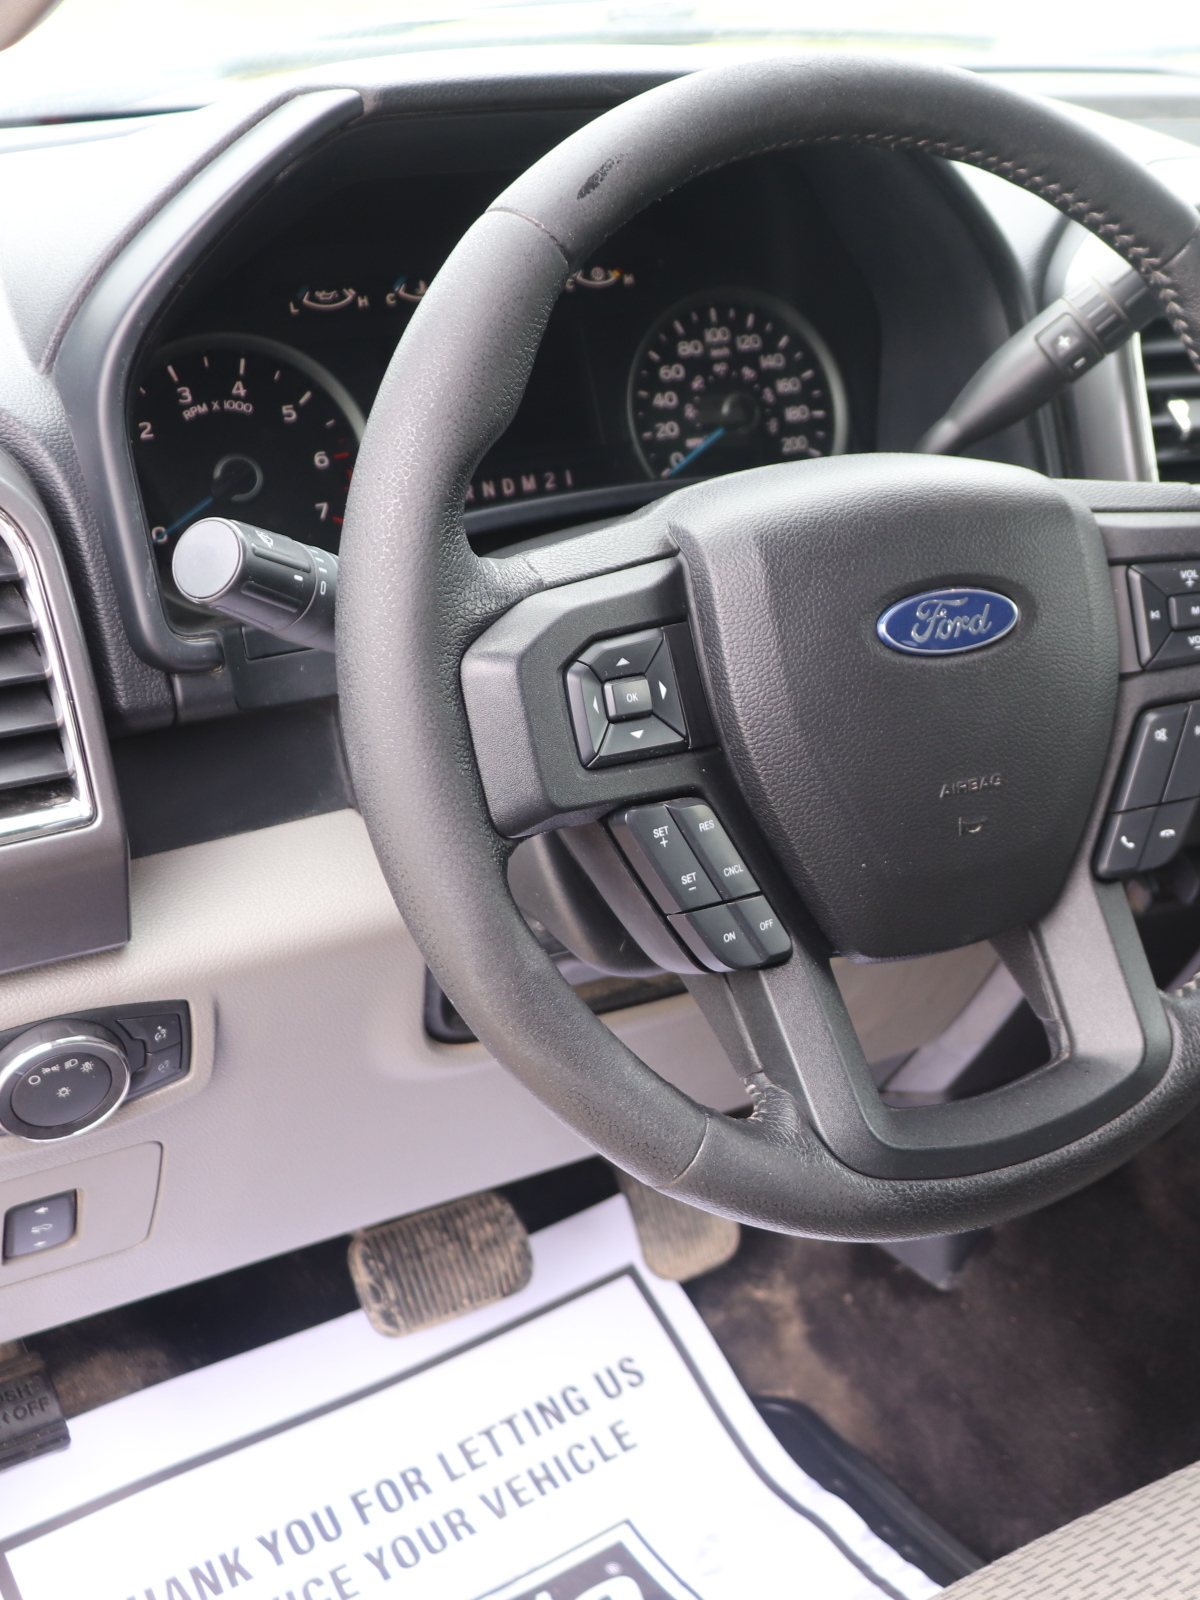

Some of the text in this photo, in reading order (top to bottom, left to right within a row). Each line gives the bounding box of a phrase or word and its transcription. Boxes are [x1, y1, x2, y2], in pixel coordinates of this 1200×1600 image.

[704, 327, 731, 343] 100
[736, 333, 762, 351] 120
[677, 340, 703, 356] 80
[759, 352, 786, 369] 140
[659, 363, 686, 381] 60
[178, 387, 193, 403] 3
[231, 381, 247, 397] 4
[652, 391, 679, 408] 40
[182, 403, 210, 421] RPM
[223, 399, 254, 414] 1000
[281, 406, 297, 422] 5
[138, 422, 154, 440] 2
[654, 421, 681, 438] 20
[314, 452, 329, 469] 6
[670, 452, 686, 467] 0
[481, 480, 496, 498] N
[501, 478, 515, 496] D
[521, 474, 537, 492] M
[544, 472, 556, 490] 2
[315, 503, 328, 520] 7
[1180, 568, 1200, 579] VOL
[1190, 605, 1200, 615] M
[910, 597, 993, 644] Ford
[625, 691, 639, 703] OK
[938, 772, 1002, 799] AIRBAG
[652, 825, 669, 840] SET
[698, 818, 715, 833] RES
[723, 863, 744, 878] CNCL
[680, 871, 697, 887] SET
[759, 917, 774, 932] OFF
[723, 930, 737, 944] ON
[12, 1395, 49, 1421] OFF
[255, 1504, 343, 1567] YOU
[349, 1466, 433, 1526] FOR
[436, 1385, 591, 1482] LETTING
[593, 1357, 645, 1399] US
[363, 1508, 477, 1582] YOUR
[478, 1420, 638, 1520] VEHICLE
